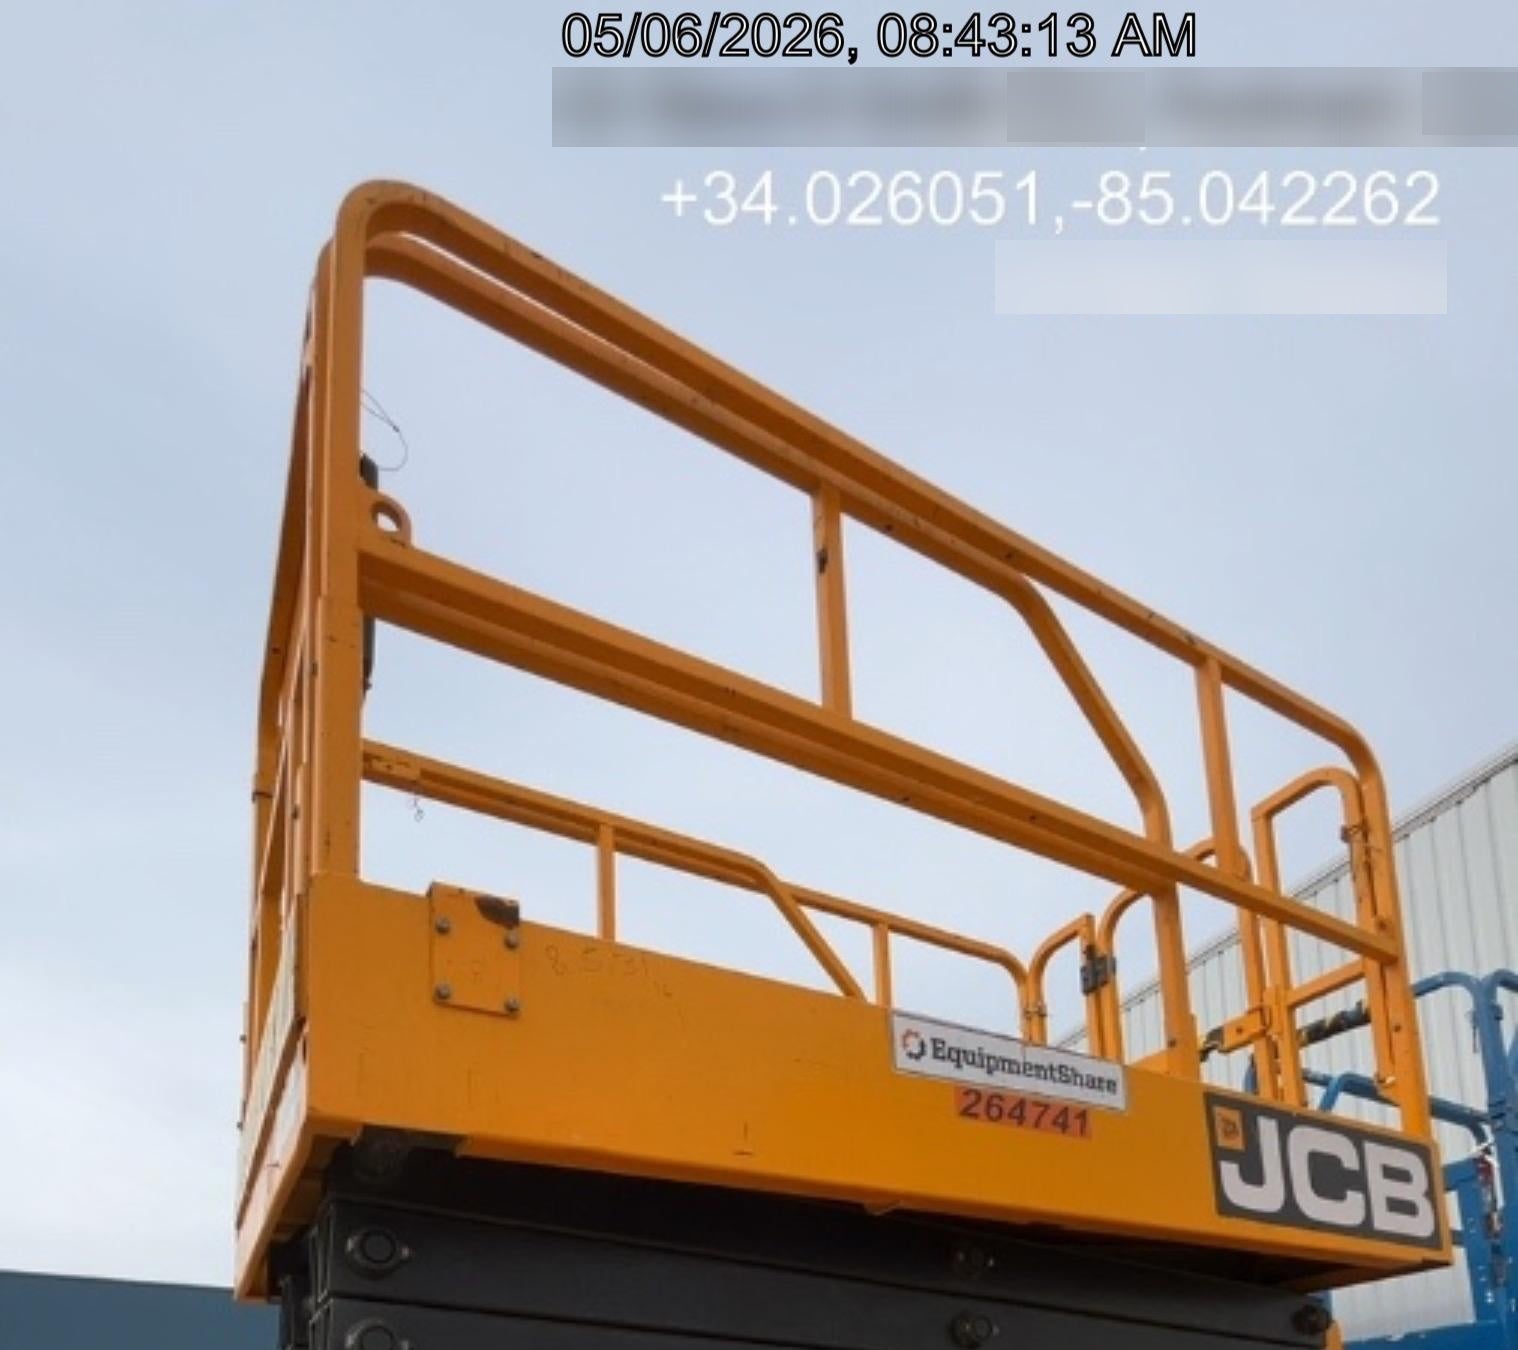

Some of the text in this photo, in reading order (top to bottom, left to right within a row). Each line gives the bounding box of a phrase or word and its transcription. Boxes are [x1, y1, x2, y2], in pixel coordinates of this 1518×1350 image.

[929, 1037, 1118, 1096] EquipmentShare
[958, 1088, 1089, 1138] 264741
[1219, 1115, 1436, 1239] JCB
